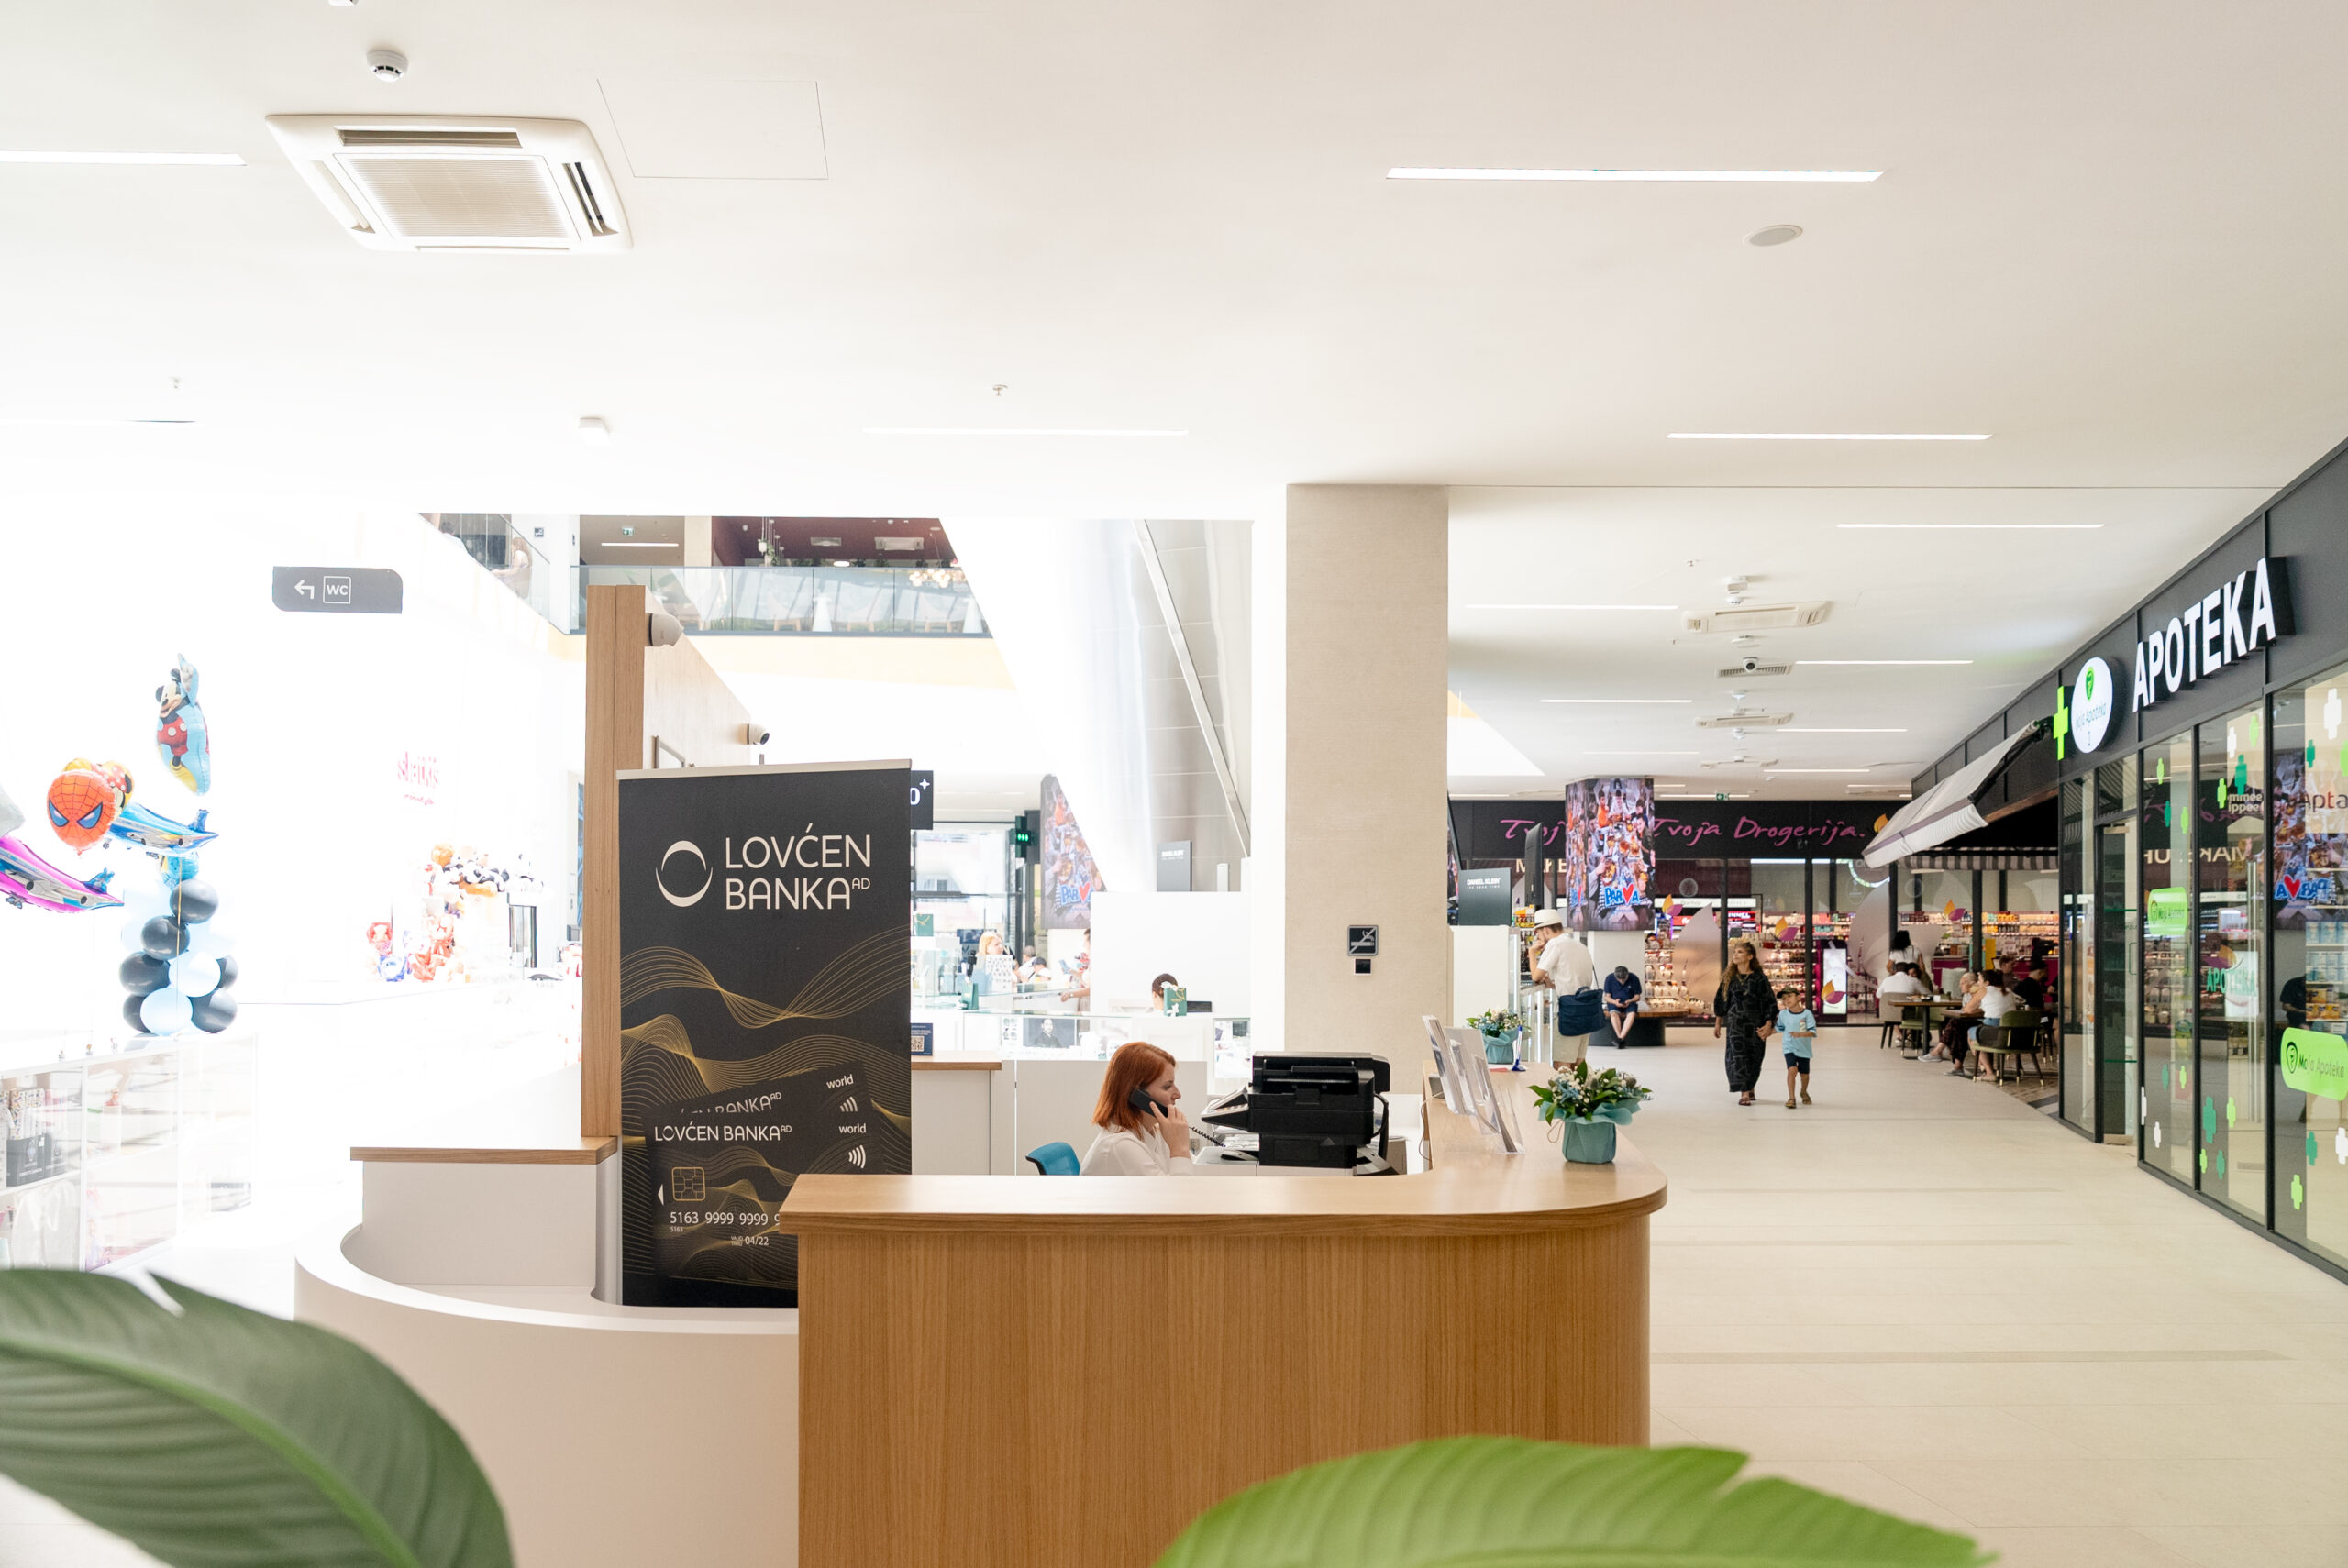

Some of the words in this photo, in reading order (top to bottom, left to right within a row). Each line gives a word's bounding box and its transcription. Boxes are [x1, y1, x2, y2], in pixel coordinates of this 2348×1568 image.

[327, 584, 349, 595] WC
[2132, 557, 2276, 712] APOTEKA
[725, 823, 871, 868] LOVĆEN
[725, 877, 851, 910] BANKA
[2298, 1053, 2315, 1075] Moja
[826, 1074, 854, 1089] world
[654, 1121, 719, 1141] LOVĆEN
[724, 1125, 781, 1141] BANKA
[838, 1123, 867, 1134] world
[670, 1211, 699, 1224] 5163
[704, 1212, 734, 1225] 9999
[739, 1213, 769, 1226] 9999
[745, 1236, 770, 1246] 04/22
